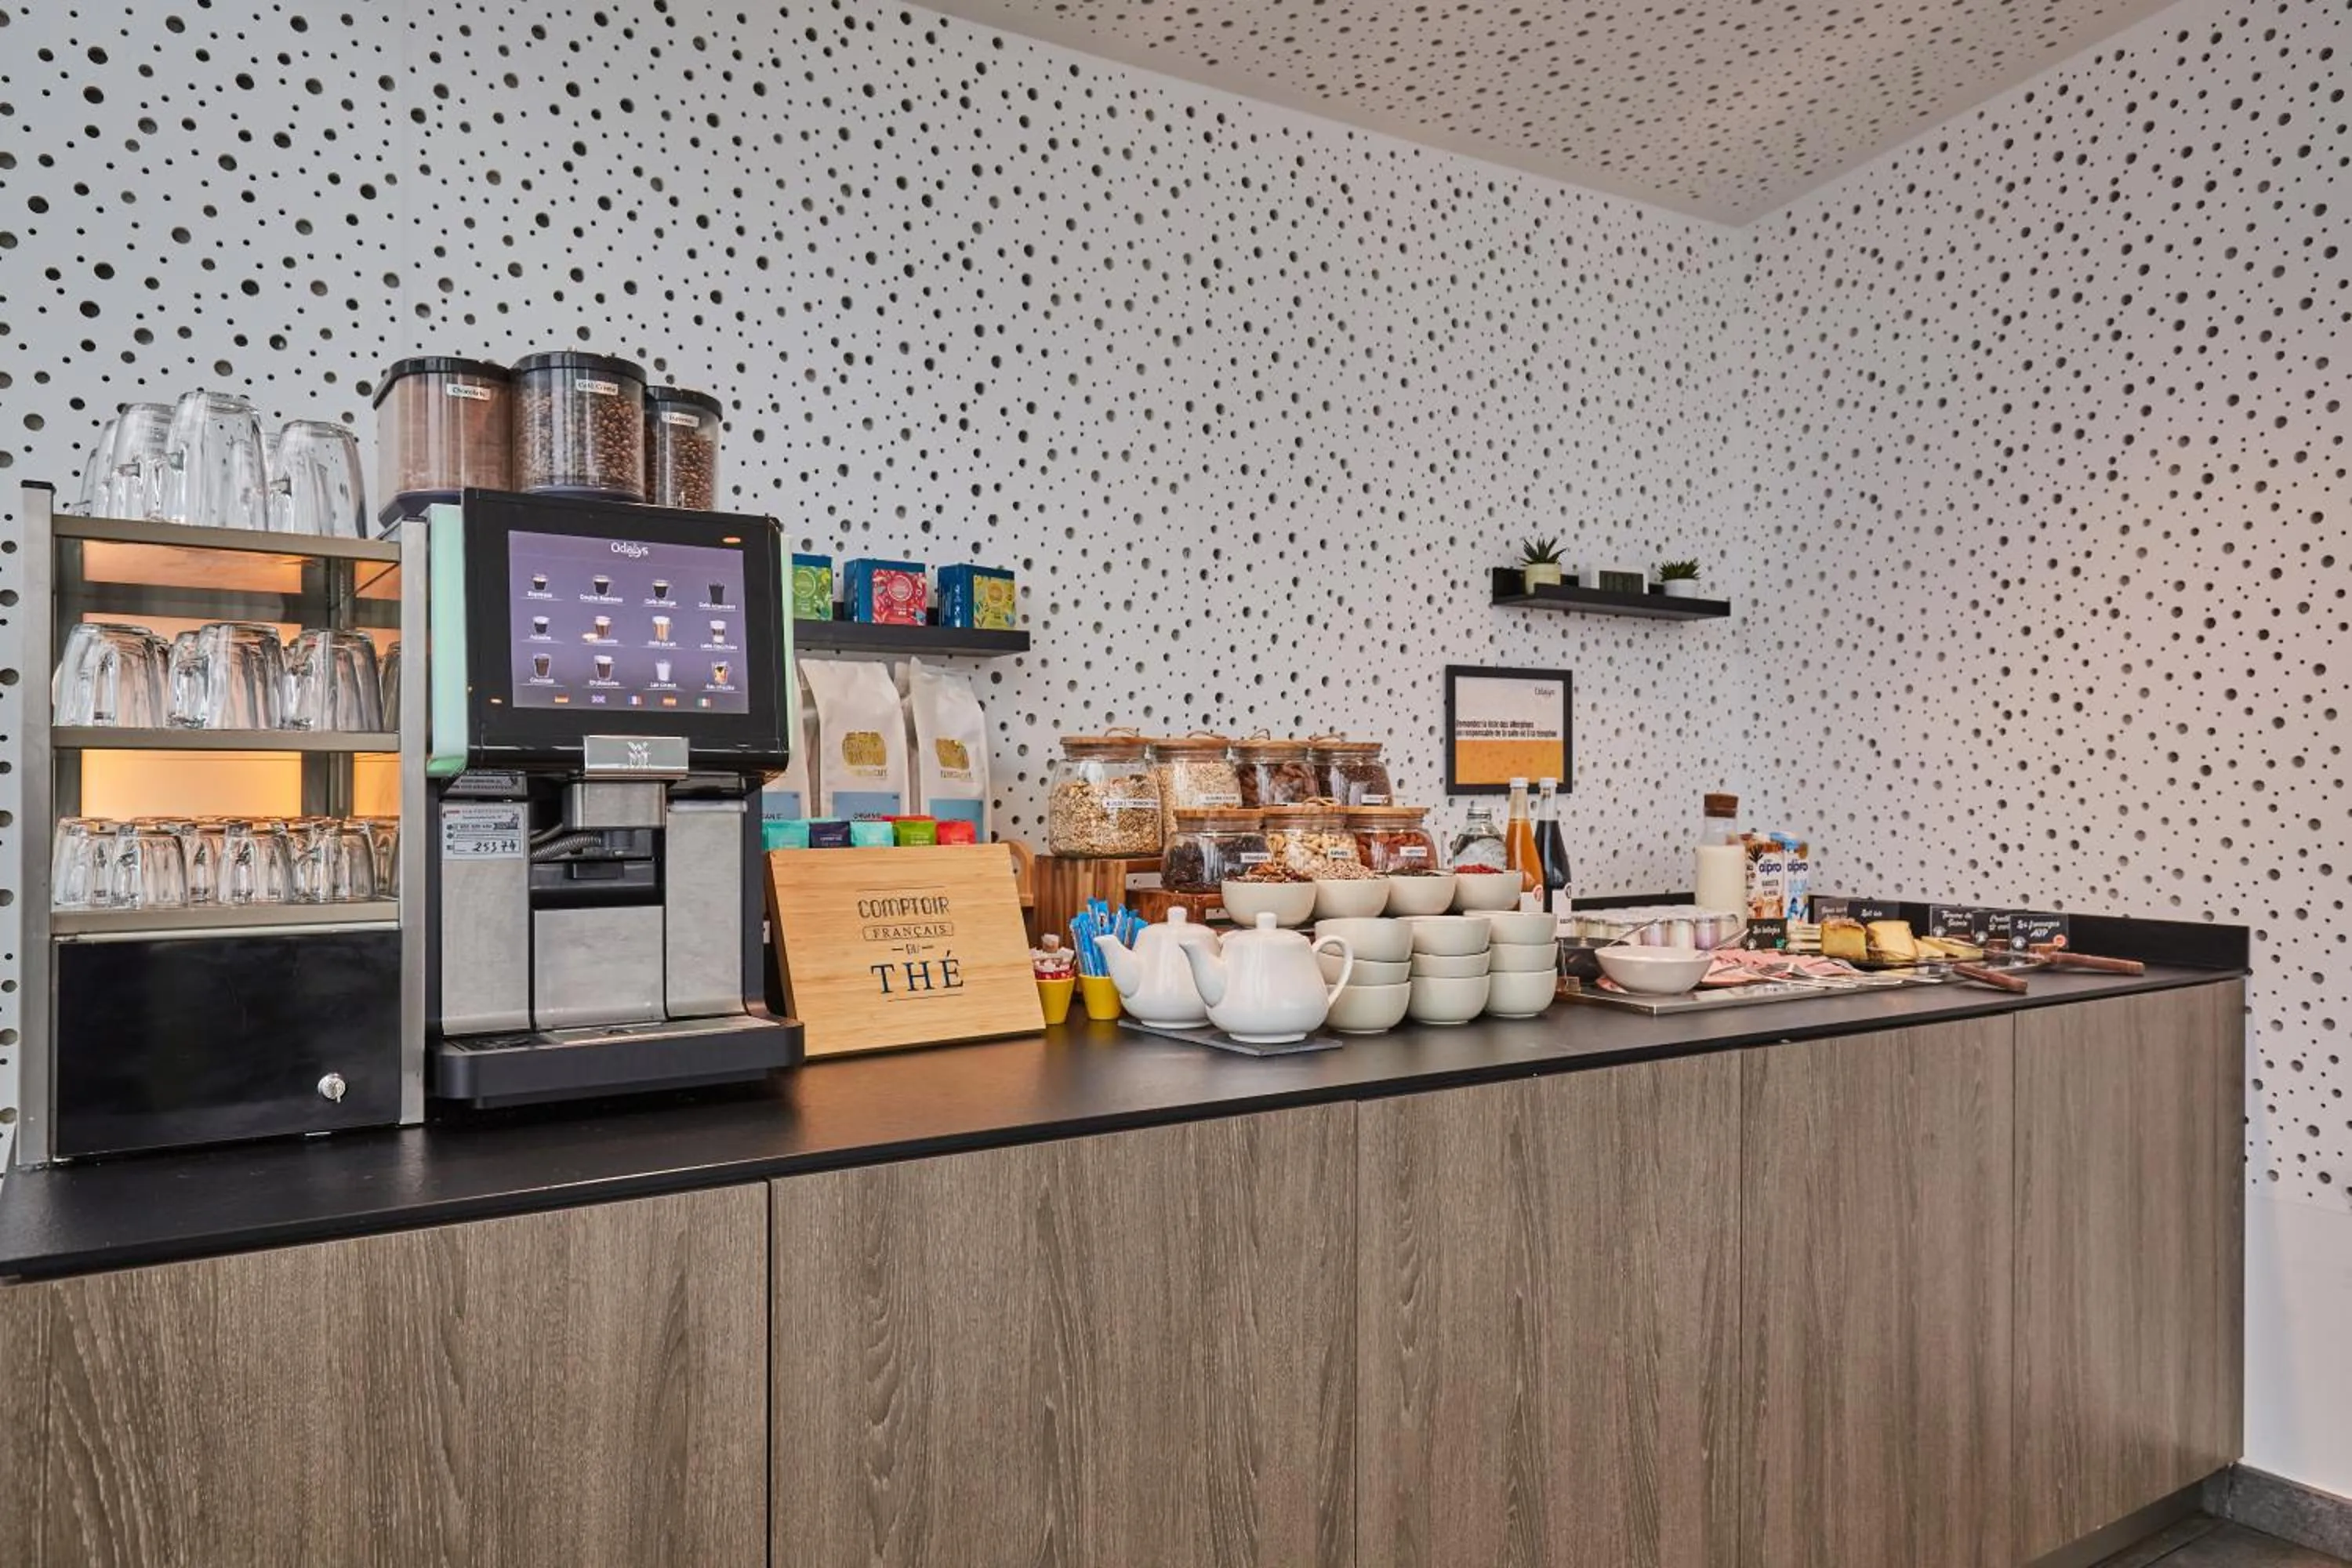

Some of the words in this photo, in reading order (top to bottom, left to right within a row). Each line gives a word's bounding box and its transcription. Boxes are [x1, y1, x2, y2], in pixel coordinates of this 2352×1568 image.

[611, 542, 649, 558] Odalys
[1759, 860, 1782, 876] alpro
[1788, 860, 1809, 875] alpro
[858, 896, 950, 919] COMPTOIR
[872, 925, 947, 938] FRANÇAIS
[870, 949, 964, 994] THÉ
